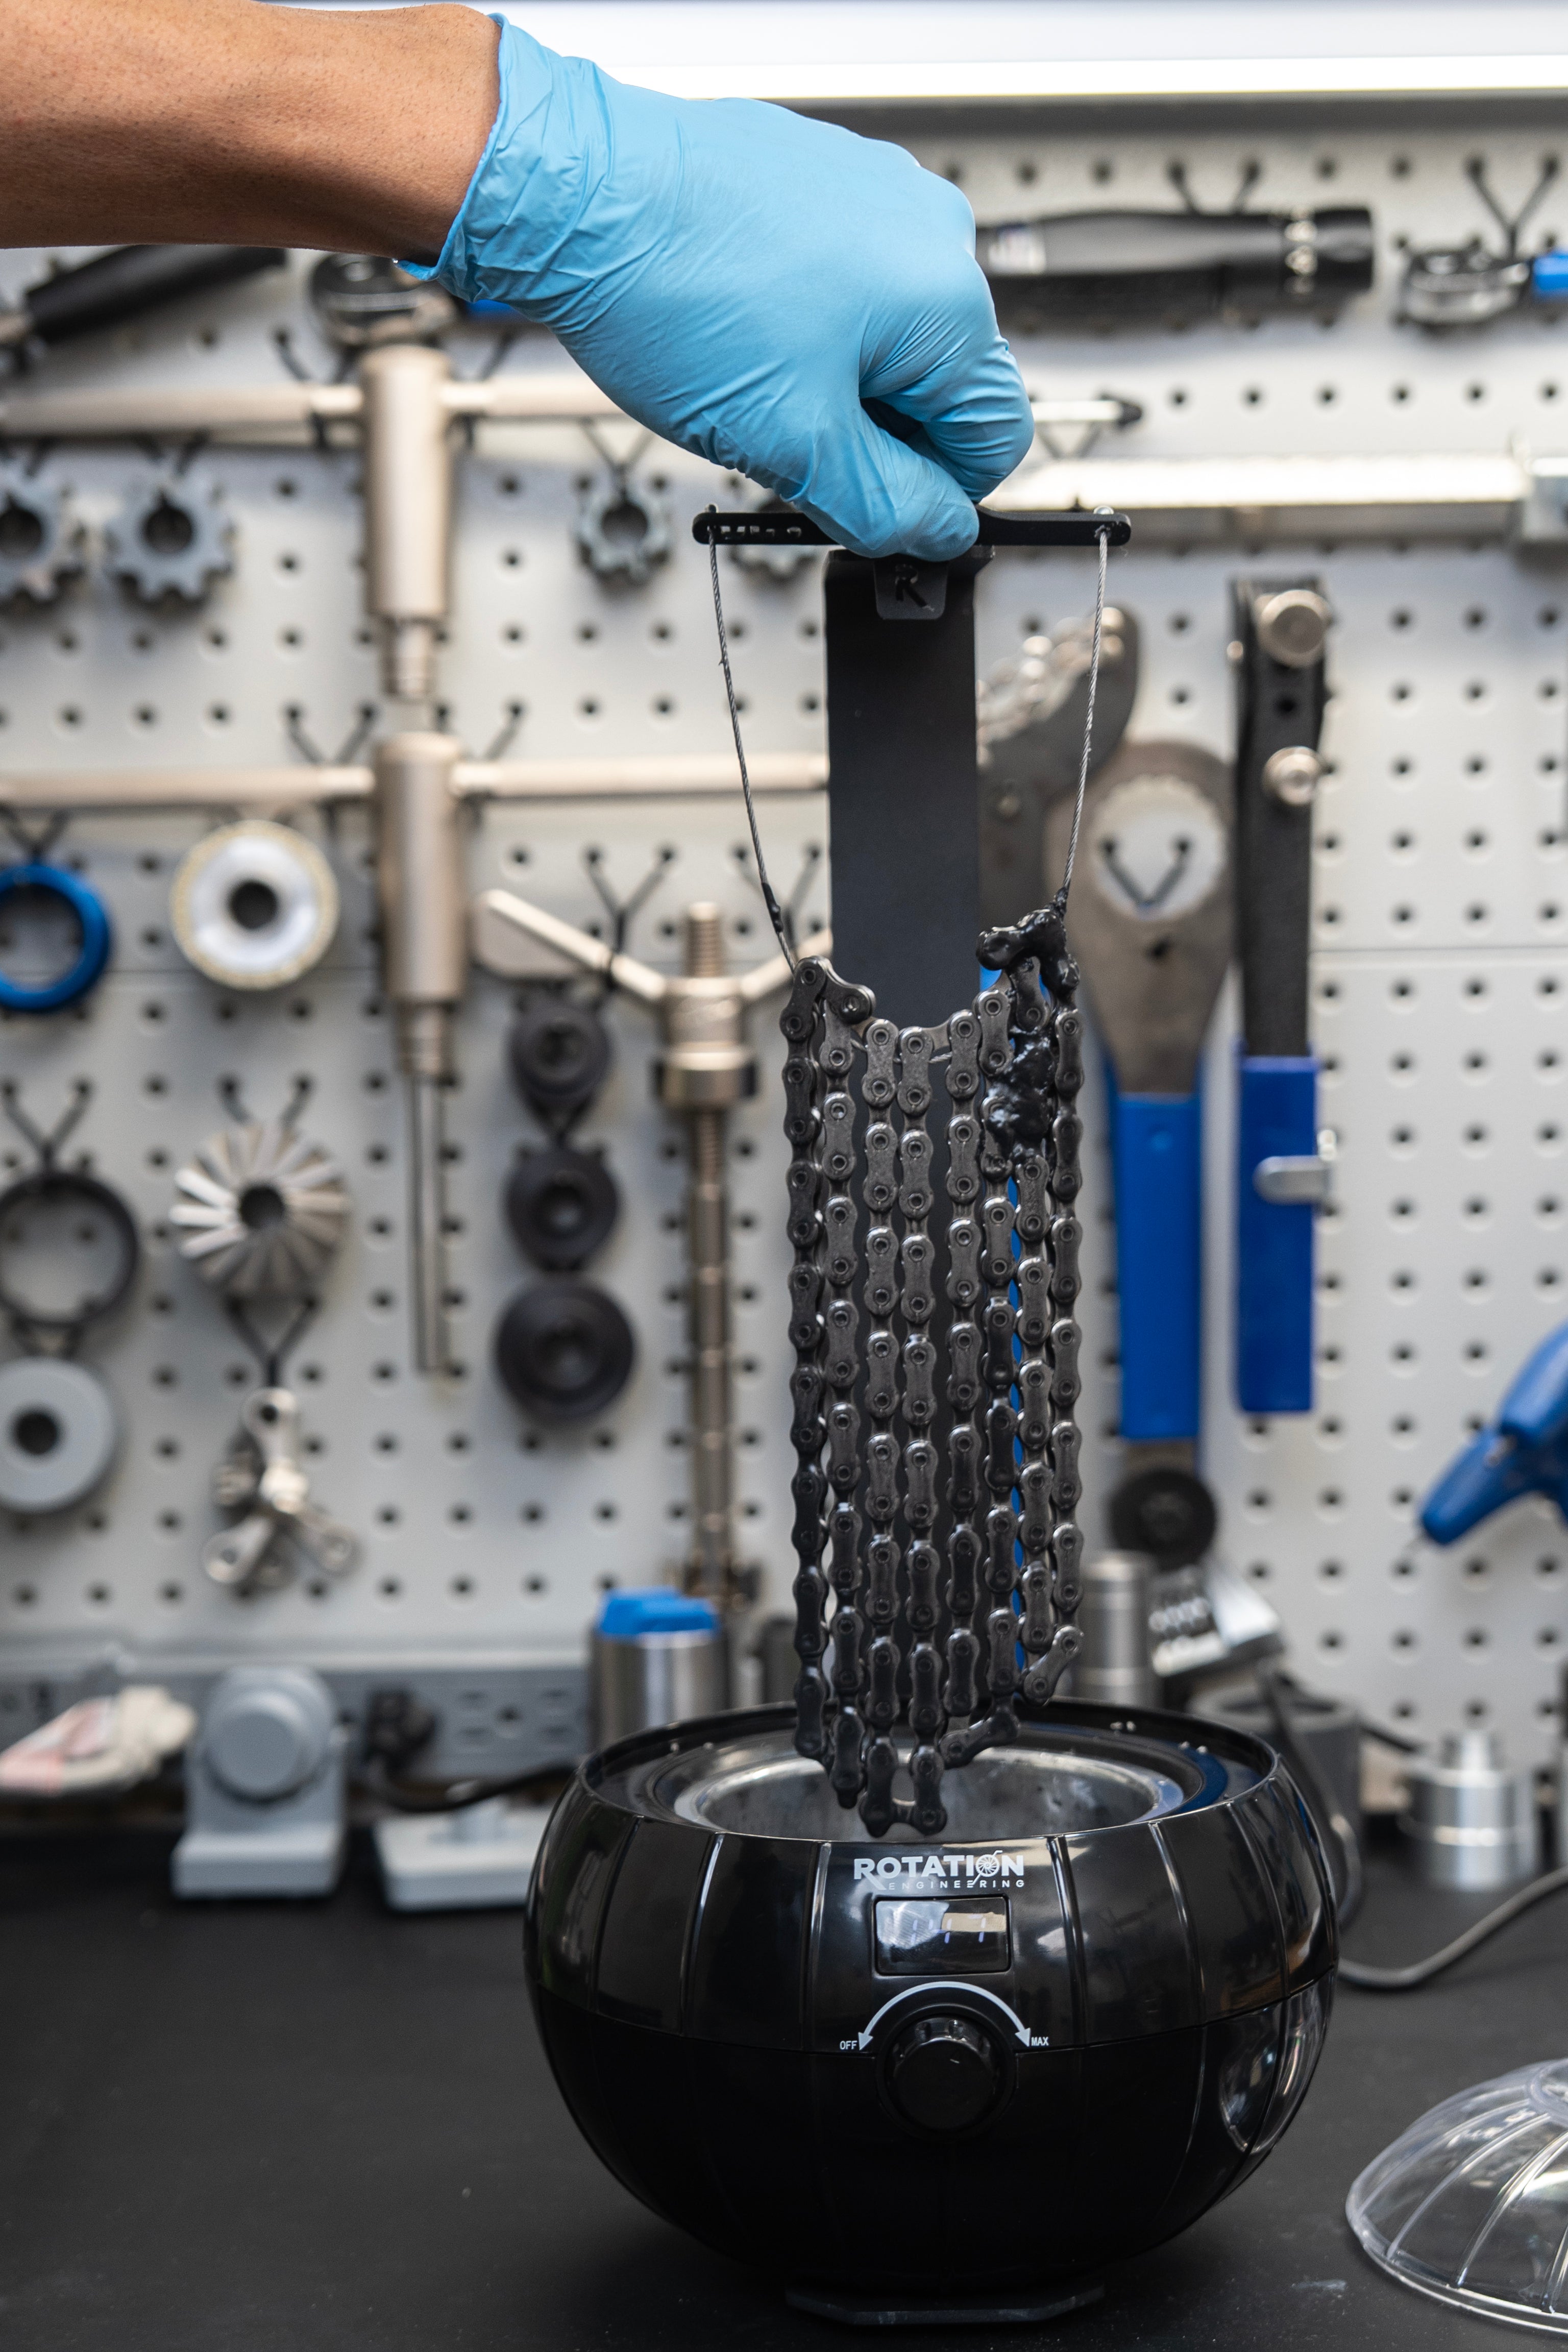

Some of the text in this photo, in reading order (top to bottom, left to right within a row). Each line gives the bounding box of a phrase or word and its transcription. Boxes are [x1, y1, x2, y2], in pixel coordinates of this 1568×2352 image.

[854, 1850, 1024, 1890] ROTATION
[889, 1879, 1024, 1890] ENGINEERING
[840, 2041, 857, 2049] OFF
[1032, 2037, 1049, 2046] MAX
